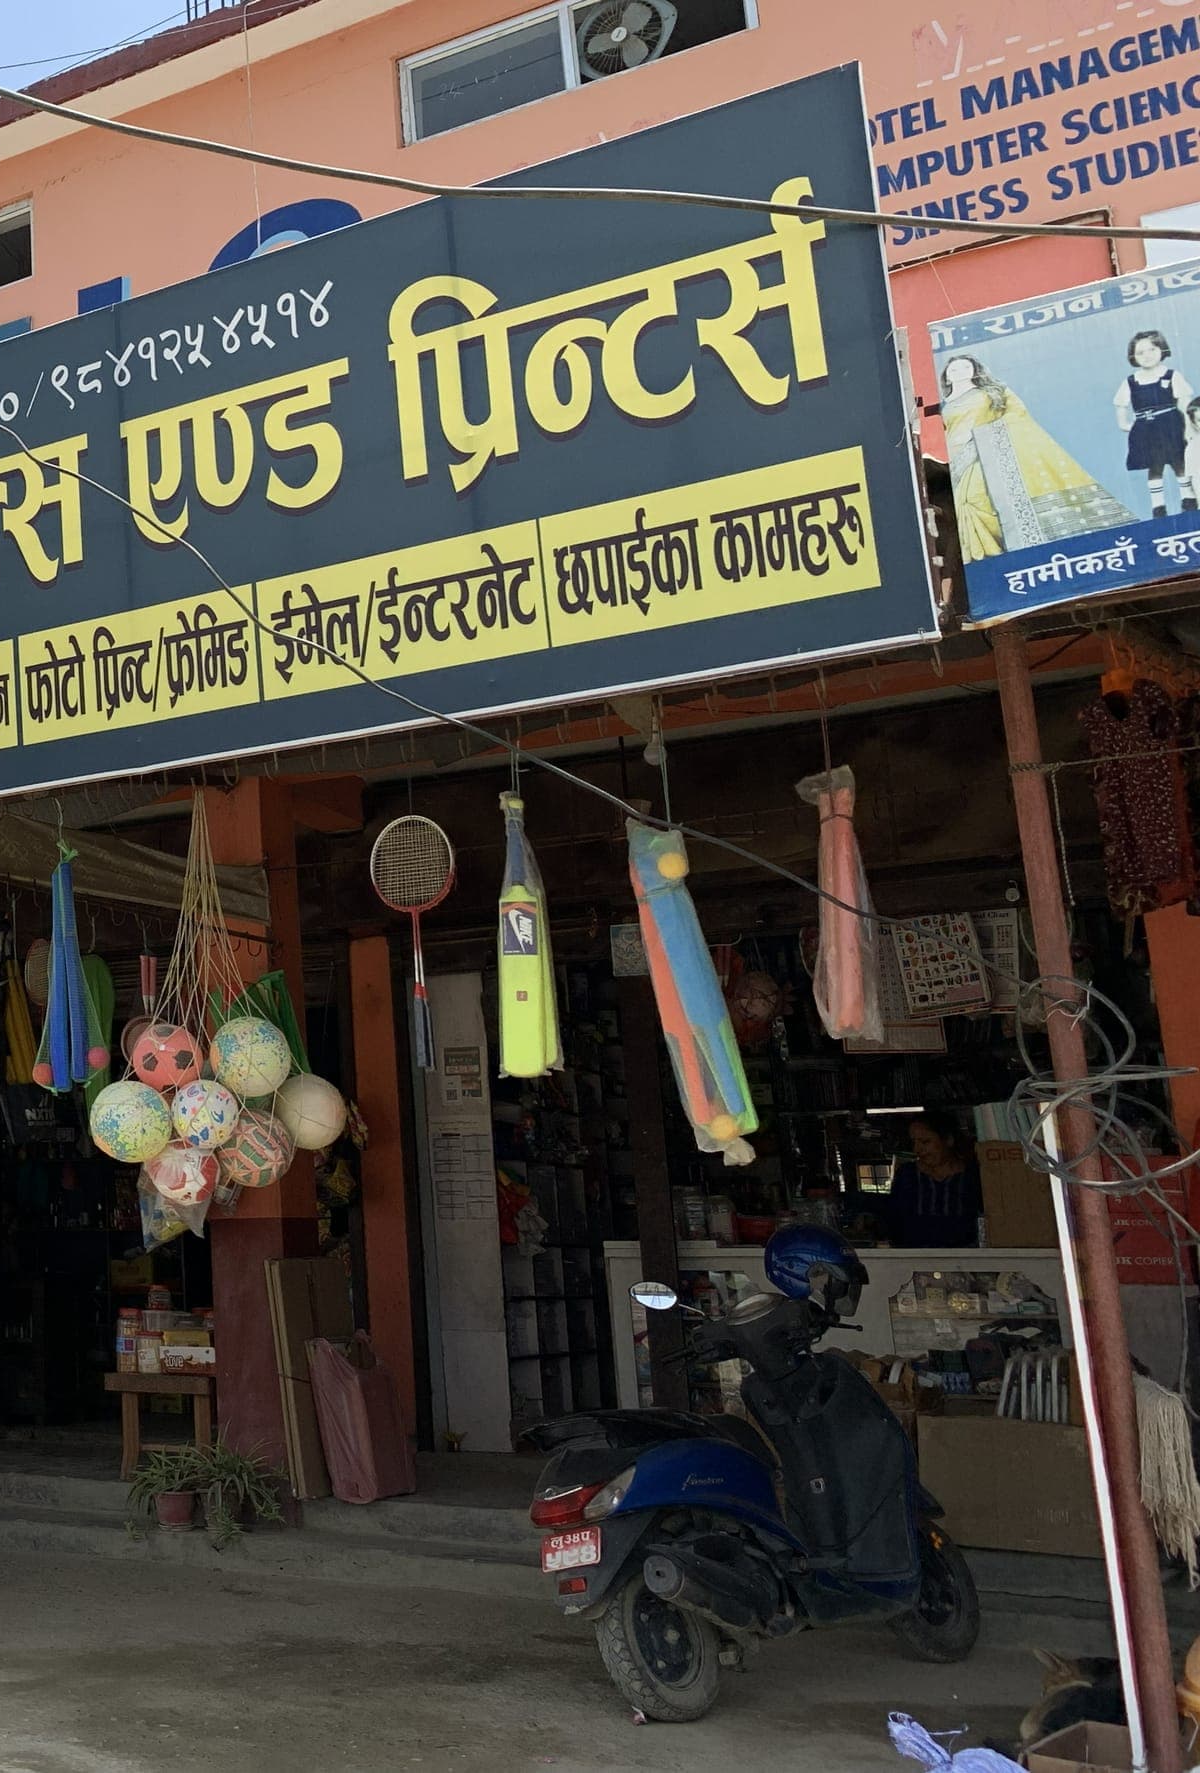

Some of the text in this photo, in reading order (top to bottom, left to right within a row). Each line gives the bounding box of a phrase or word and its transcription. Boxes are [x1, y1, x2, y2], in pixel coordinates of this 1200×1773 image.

[868, 16, 1200, 149] TEL MANAGEM
[884, 126, 1200, 247] SINESS STUDIE
[120, 357, 349, 545] एण्ड
[387, 176, 830, 494] प्रिन्टर्स
[982, 289, 1104, 335] राजन
[25, 633, 85, 723] फोटो
[553, 508, 703, 617] छपाईका
[1003, 536, 1138, 595] हामीकहाँ
[519, 915, 533, 946] NIKE
